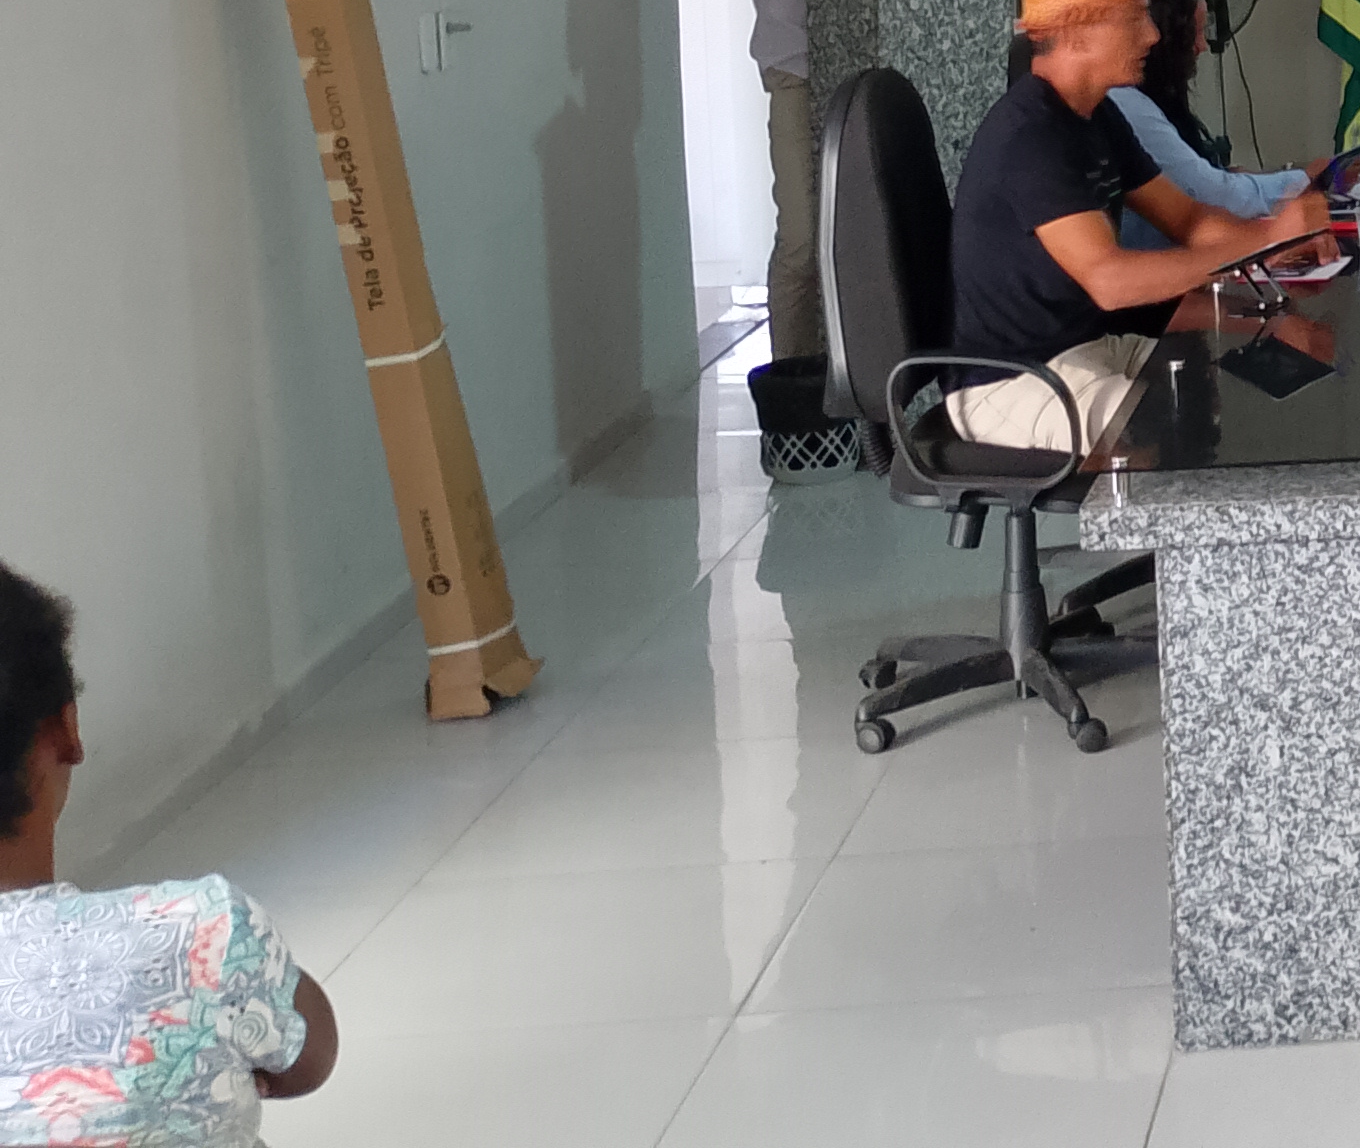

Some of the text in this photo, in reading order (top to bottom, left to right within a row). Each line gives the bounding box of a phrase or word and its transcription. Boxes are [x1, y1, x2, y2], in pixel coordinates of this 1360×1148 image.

[323, 85, 347, 131] com
[333, 135, 369, 229] Projeção
[356, 234, 375, 261] de
[362, 267, 386, 311] Tela
